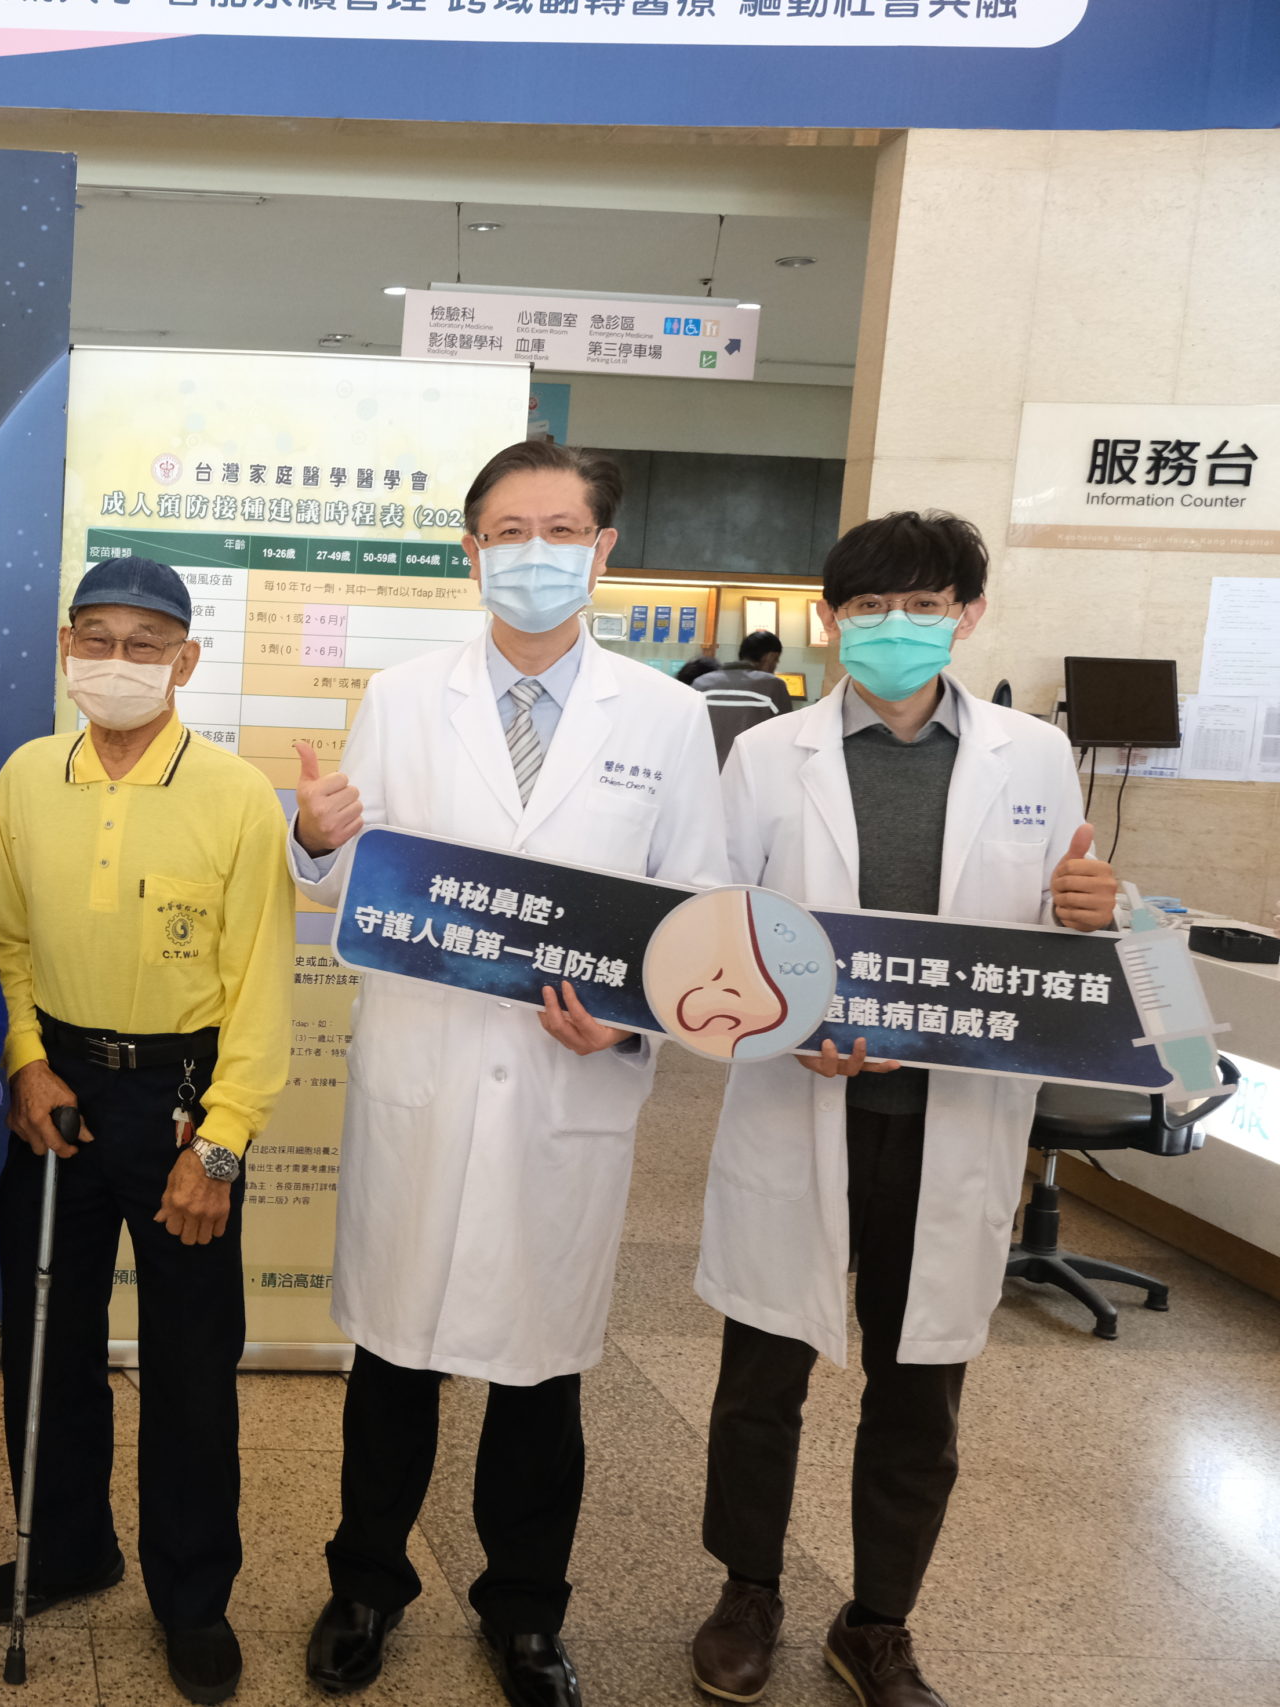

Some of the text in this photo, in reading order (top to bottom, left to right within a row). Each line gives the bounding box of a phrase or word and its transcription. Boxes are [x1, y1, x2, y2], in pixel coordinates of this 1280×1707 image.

[431, 305, 475, 322] 檢驗科
[517, 310, 578, 328] 心電圖室
[429, 322, 493, 331] Laboratory Medicine
[590, 314, 635, 331] 急診區
[428, 331, 503, 351] 影像醫學科
[589, 330, 624, 339] Emergency
[427, 347, 458, 356] Radiology
[515, 338, 546, 353] 血庫
[588, 341, 662, 360] 第三停車場
[586, 356, 610, 364] Parking
[1086, 438, 1259, 487] 服務台
[194, 461, 429, 491] 台灣家庭醫學醫學會
[1086, 492, 1247, 508] Information Counter
[100, 490, 466, 530] 成人預防接種建議時程表 (202
[224, 538, 246, 551] 年齡
[89, 546, 132, 559] 疫苗種類
[262, 548, 296, 560] 19-26歲
[316, 550, 351, 562] 27-49歲
[363, 552, 397, 564] 50-59歲
[405, 554, 441, 566] 60-64歲
[353, 905, 629, 988] 守護人體第一道防線
